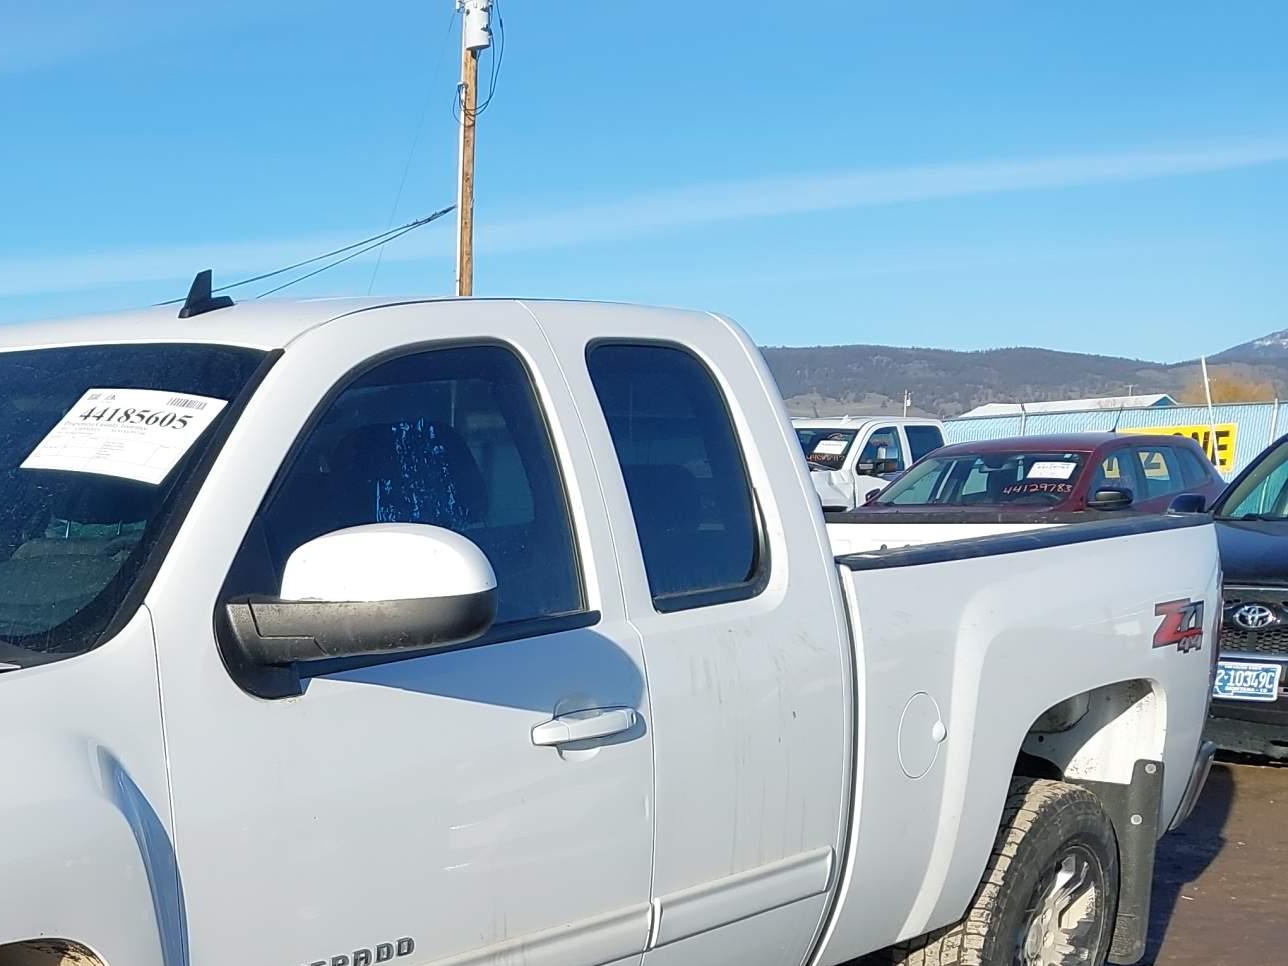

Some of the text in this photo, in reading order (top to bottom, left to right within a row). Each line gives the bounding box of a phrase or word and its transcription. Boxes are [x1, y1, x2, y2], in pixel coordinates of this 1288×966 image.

[79, 406, 194, 430] 44185605
[1003, 483, 1072, 494] 44129783
[1152, 597, 1204, 649] Z71
